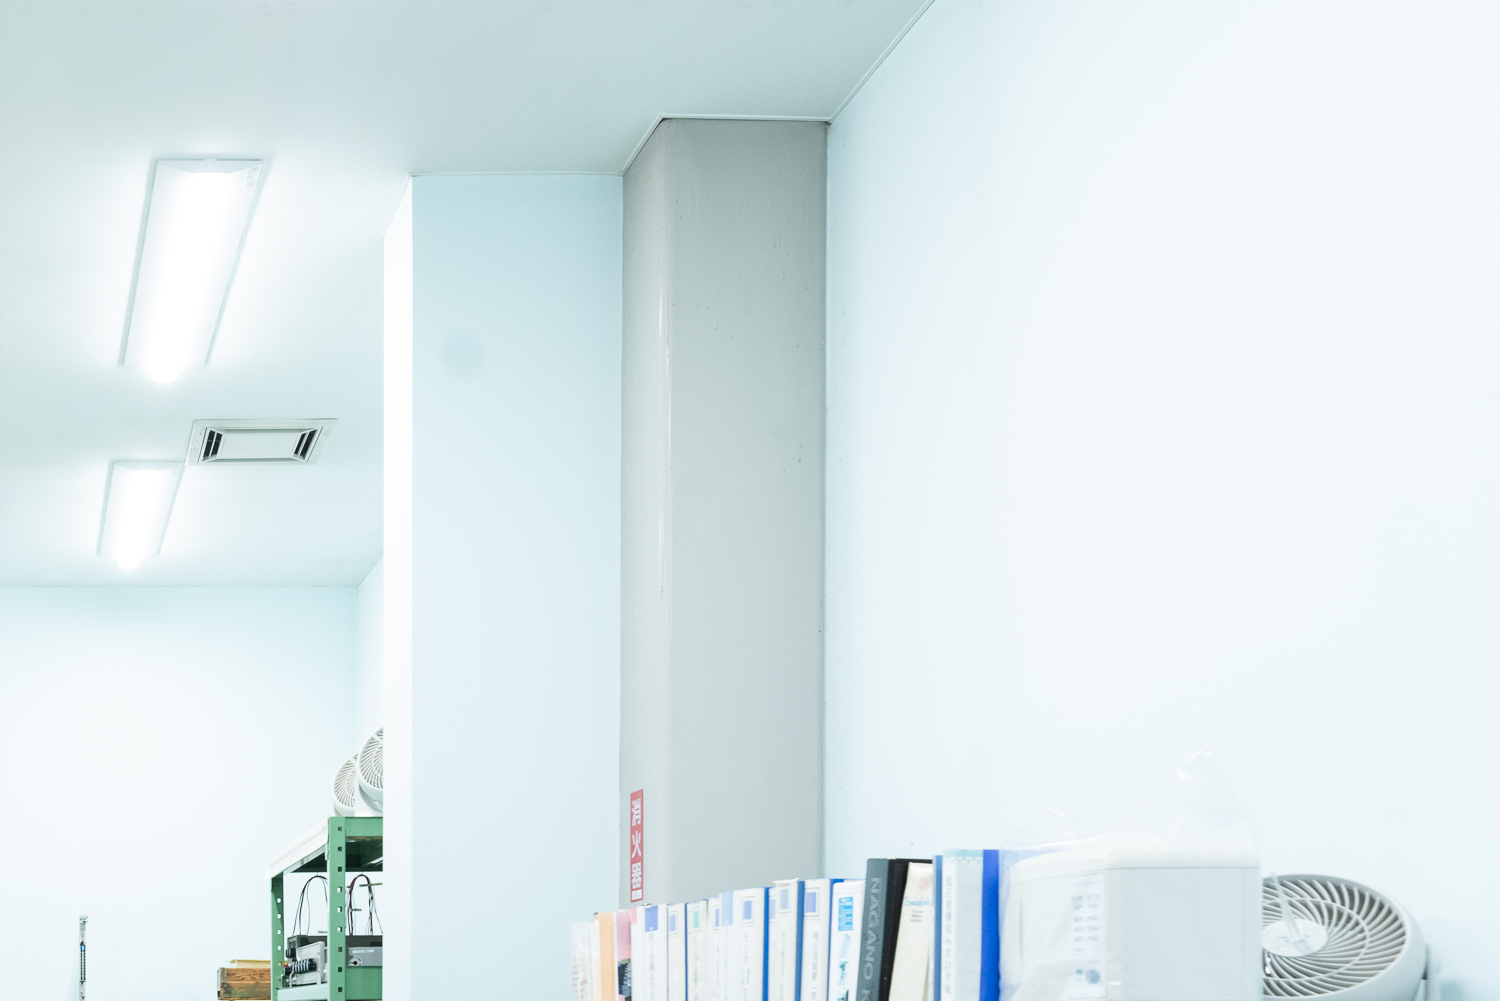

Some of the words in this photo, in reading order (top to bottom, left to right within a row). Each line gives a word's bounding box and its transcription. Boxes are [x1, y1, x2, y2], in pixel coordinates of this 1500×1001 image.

[631, 797, 642, 890] 消火器
[862, 876, 883, 981] NAGANO
